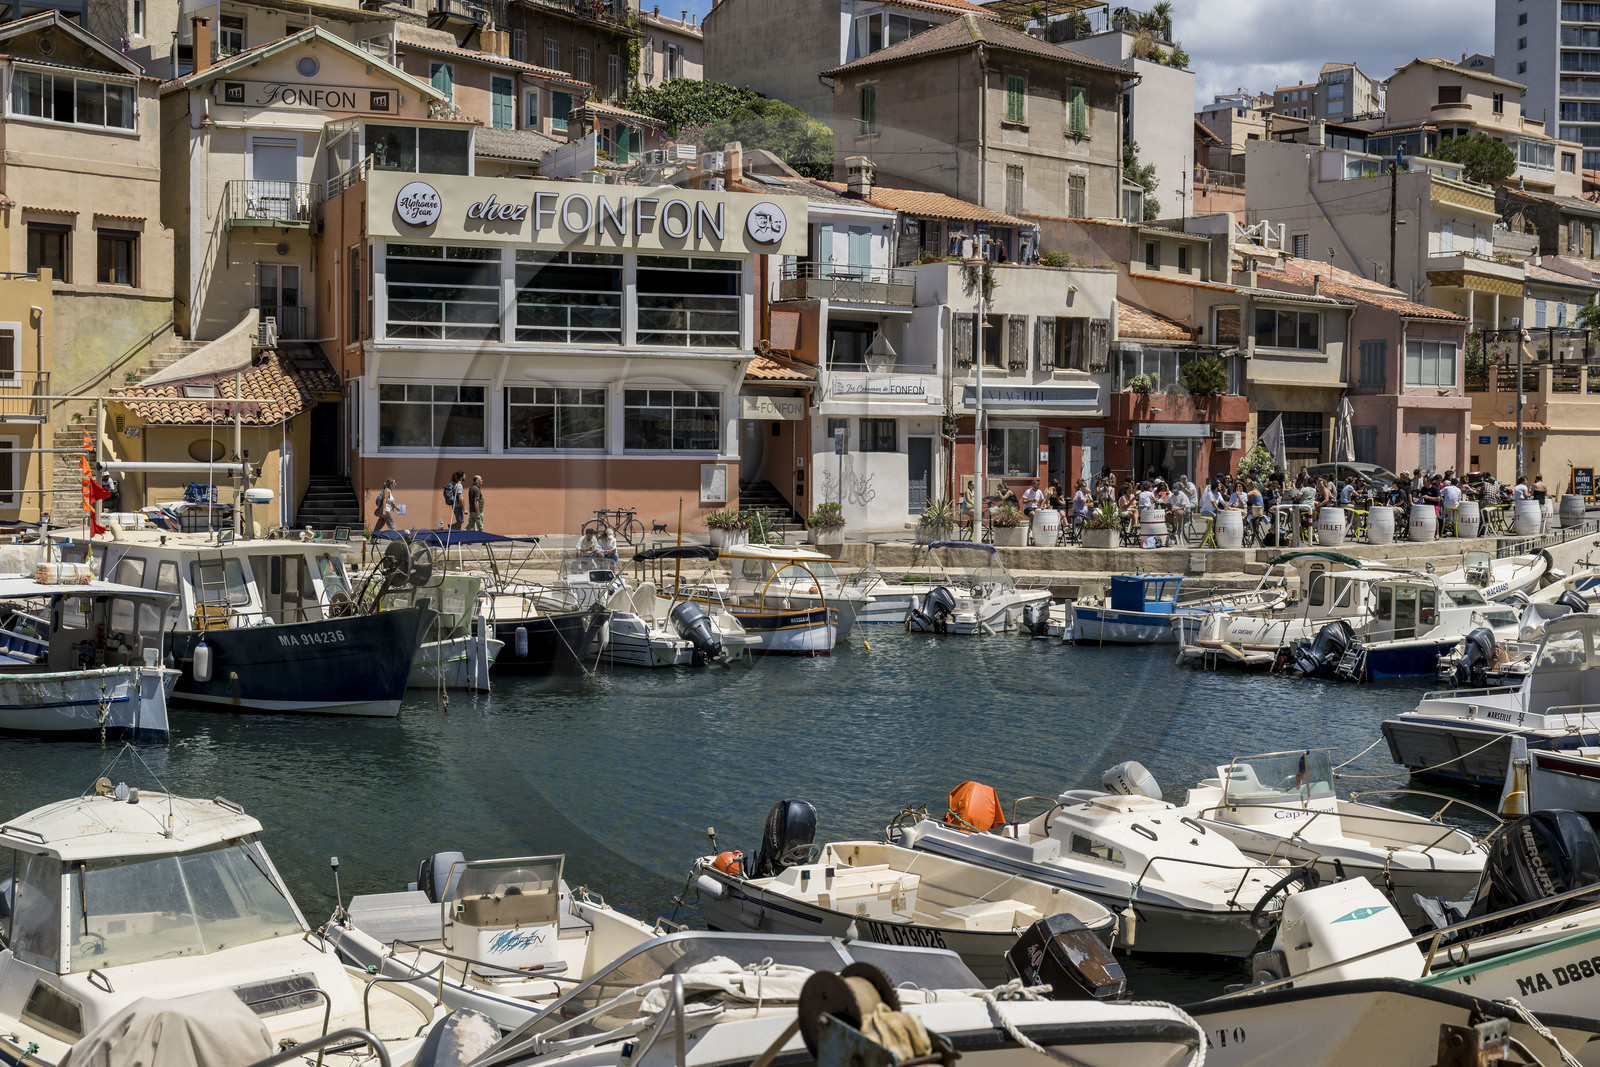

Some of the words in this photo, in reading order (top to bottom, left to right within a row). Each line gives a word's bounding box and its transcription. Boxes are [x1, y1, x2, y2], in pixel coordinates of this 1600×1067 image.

[256, 83, 356, 108] FONFON
[400, 197, 438, 209] Alphonse
[411, 207, 432, 219] Jean
[467, 194, 530, 221] chez
[535, 192, 725, 240] FONFON
[890, 385, 925, 395] FONFON
[761, 403, 802, 414] FONFON
[1320, 523, 1343, 531] LILLET
[278, 635, 300, 646] MA
[300, 630, 345, 646] 914236
[1487, 711, 1512, 723] MARSEILLE
[1521, 824, 1559, 897] MERCURY
[869, 921, 893, 946] MA
[1515, 973, 1553, 997] MA
